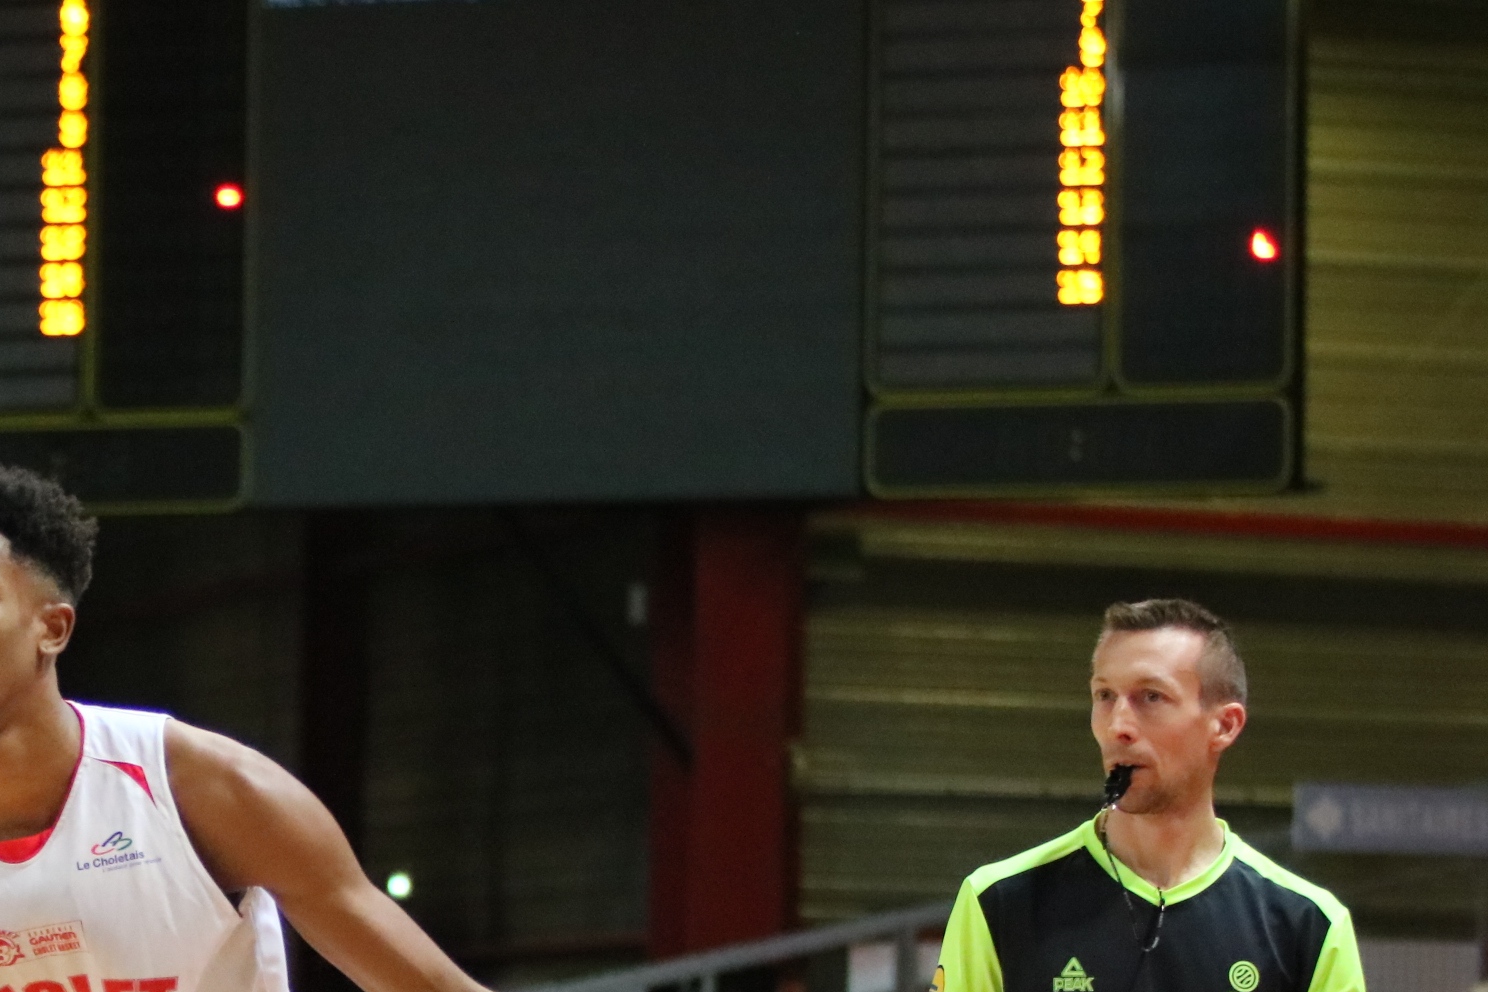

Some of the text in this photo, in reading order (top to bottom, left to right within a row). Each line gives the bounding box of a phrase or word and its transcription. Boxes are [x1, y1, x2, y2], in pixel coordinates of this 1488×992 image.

[76, 861, 90, 871] Le
[92, 850, 145, 868] Choletais
[1053, 977, 1094, 992] PEAK
